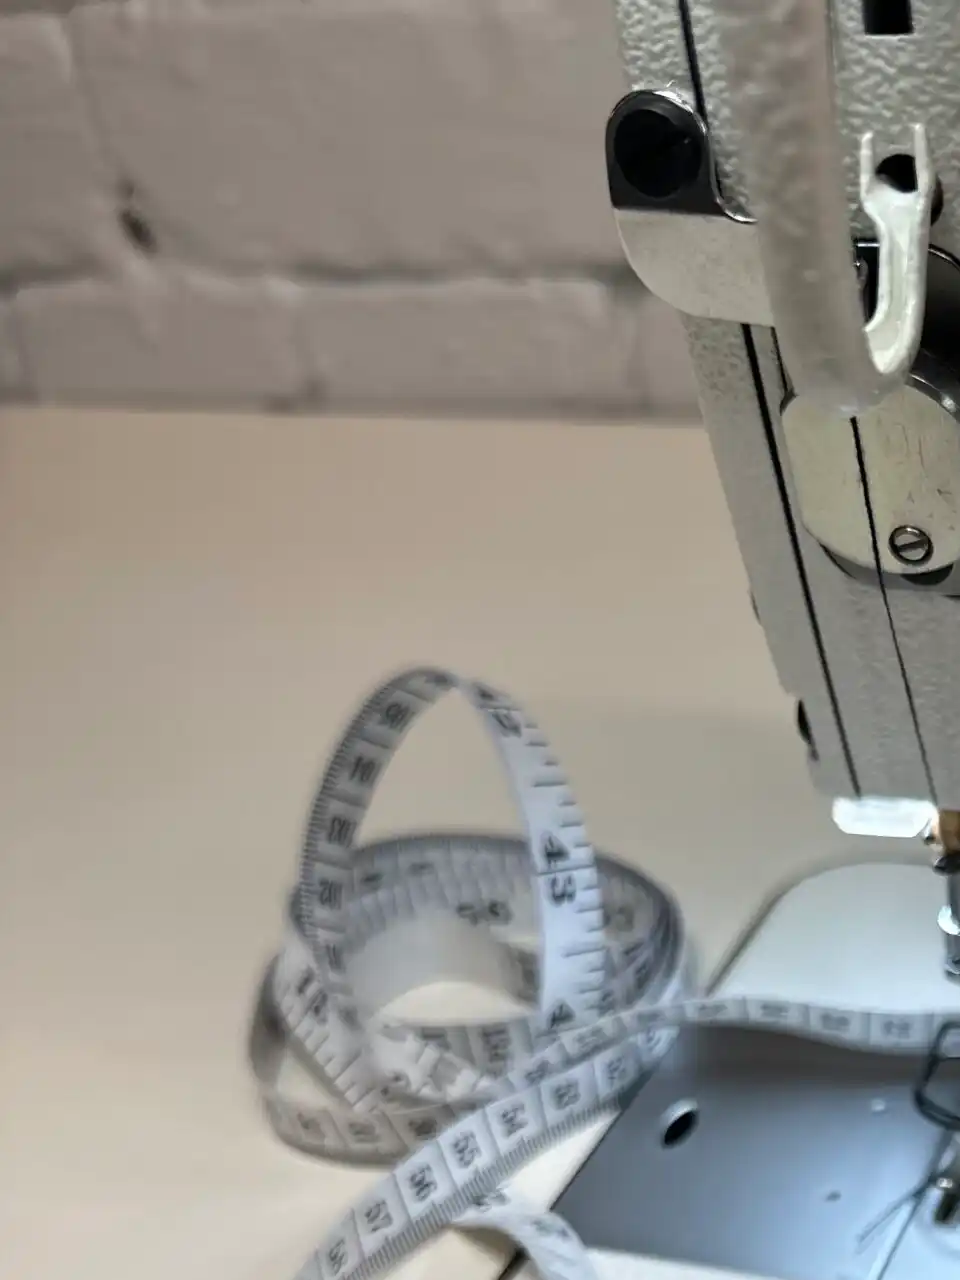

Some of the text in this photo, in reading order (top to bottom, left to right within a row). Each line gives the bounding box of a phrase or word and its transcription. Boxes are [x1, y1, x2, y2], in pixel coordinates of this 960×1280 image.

[543, 833, 576, 906] 43
[453, 1130, 482, 1170] 55
[409, 1163, 438, 1202] 56
[364, 1199, 394, 1233] 57
